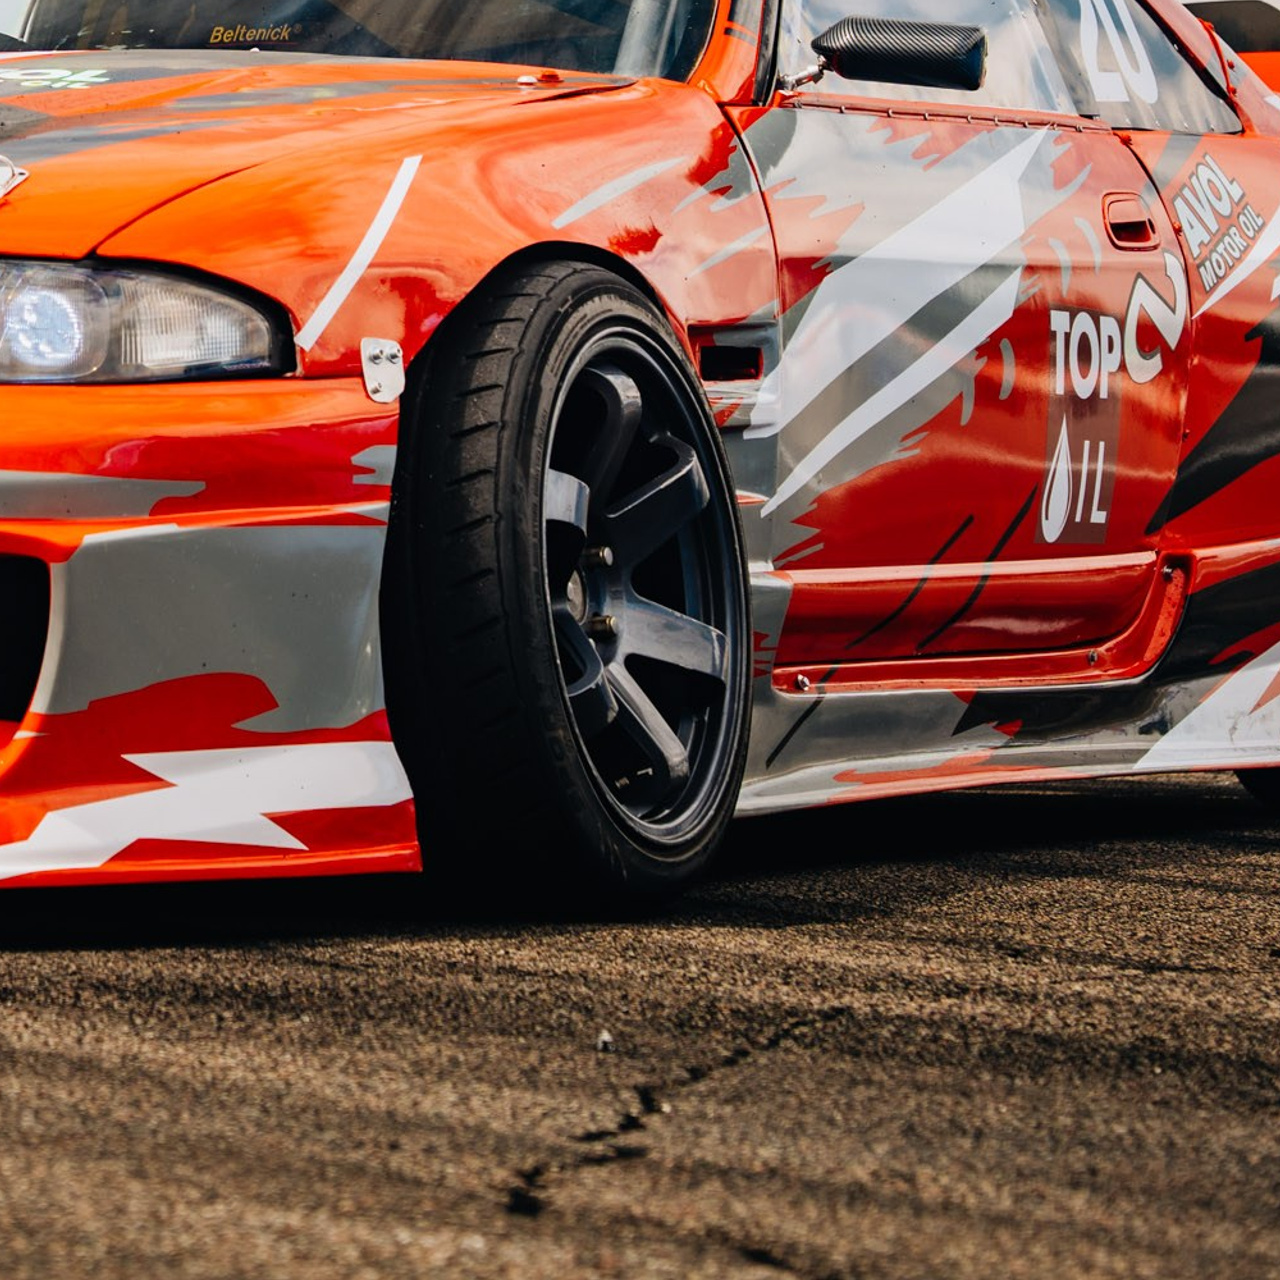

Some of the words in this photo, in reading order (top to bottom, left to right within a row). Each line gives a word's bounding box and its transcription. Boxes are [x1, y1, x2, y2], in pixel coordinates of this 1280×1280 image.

[20, 80, 92, 89] OIL
[1198, 226, 1247, 292] MOTOR
[1238, 204, 1264, 239] OIL
[1050, 310, 1121, 400] TOP
